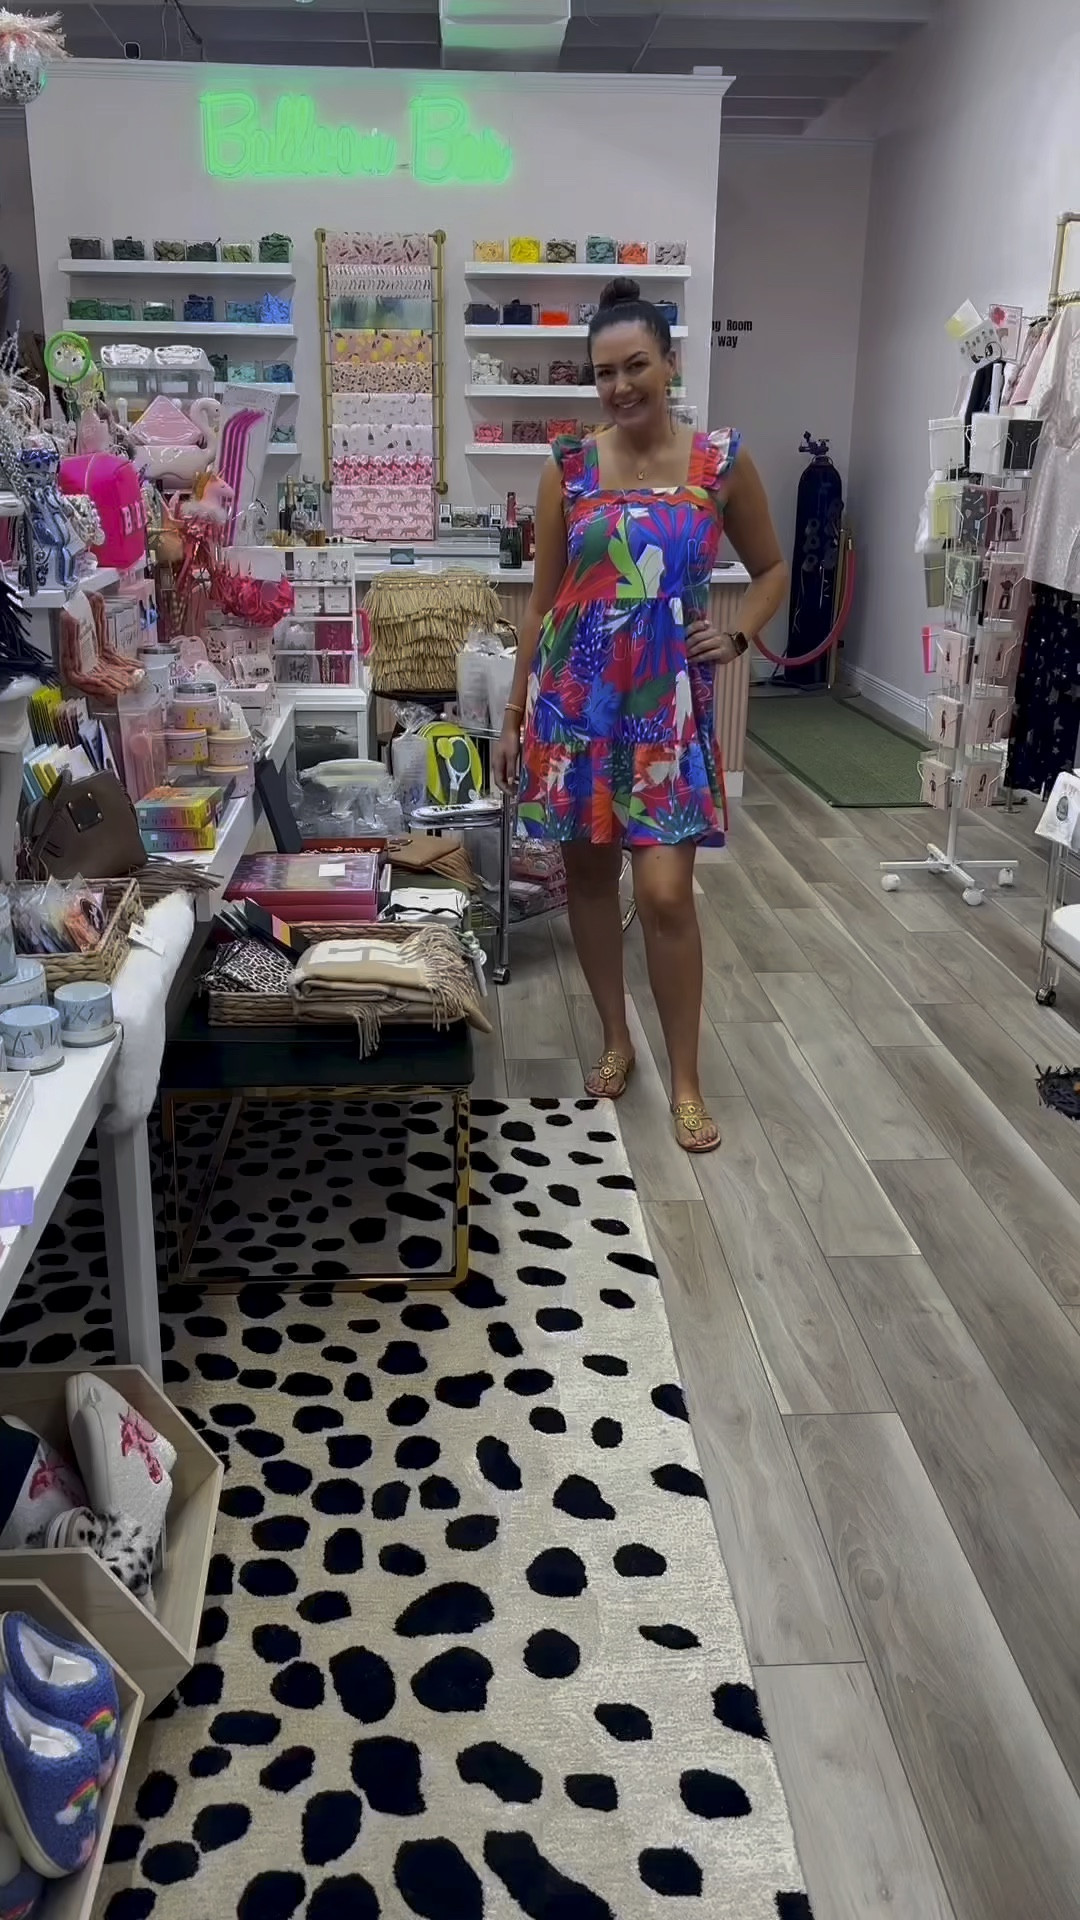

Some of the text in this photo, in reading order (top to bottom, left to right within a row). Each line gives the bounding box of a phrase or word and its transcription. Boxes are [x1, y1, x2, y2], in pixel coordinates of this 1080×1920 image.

[199, 91, 512, 182] Balloon Bar
[726, 319, 753, 331] Room
[717, 335, 738, 348] way
